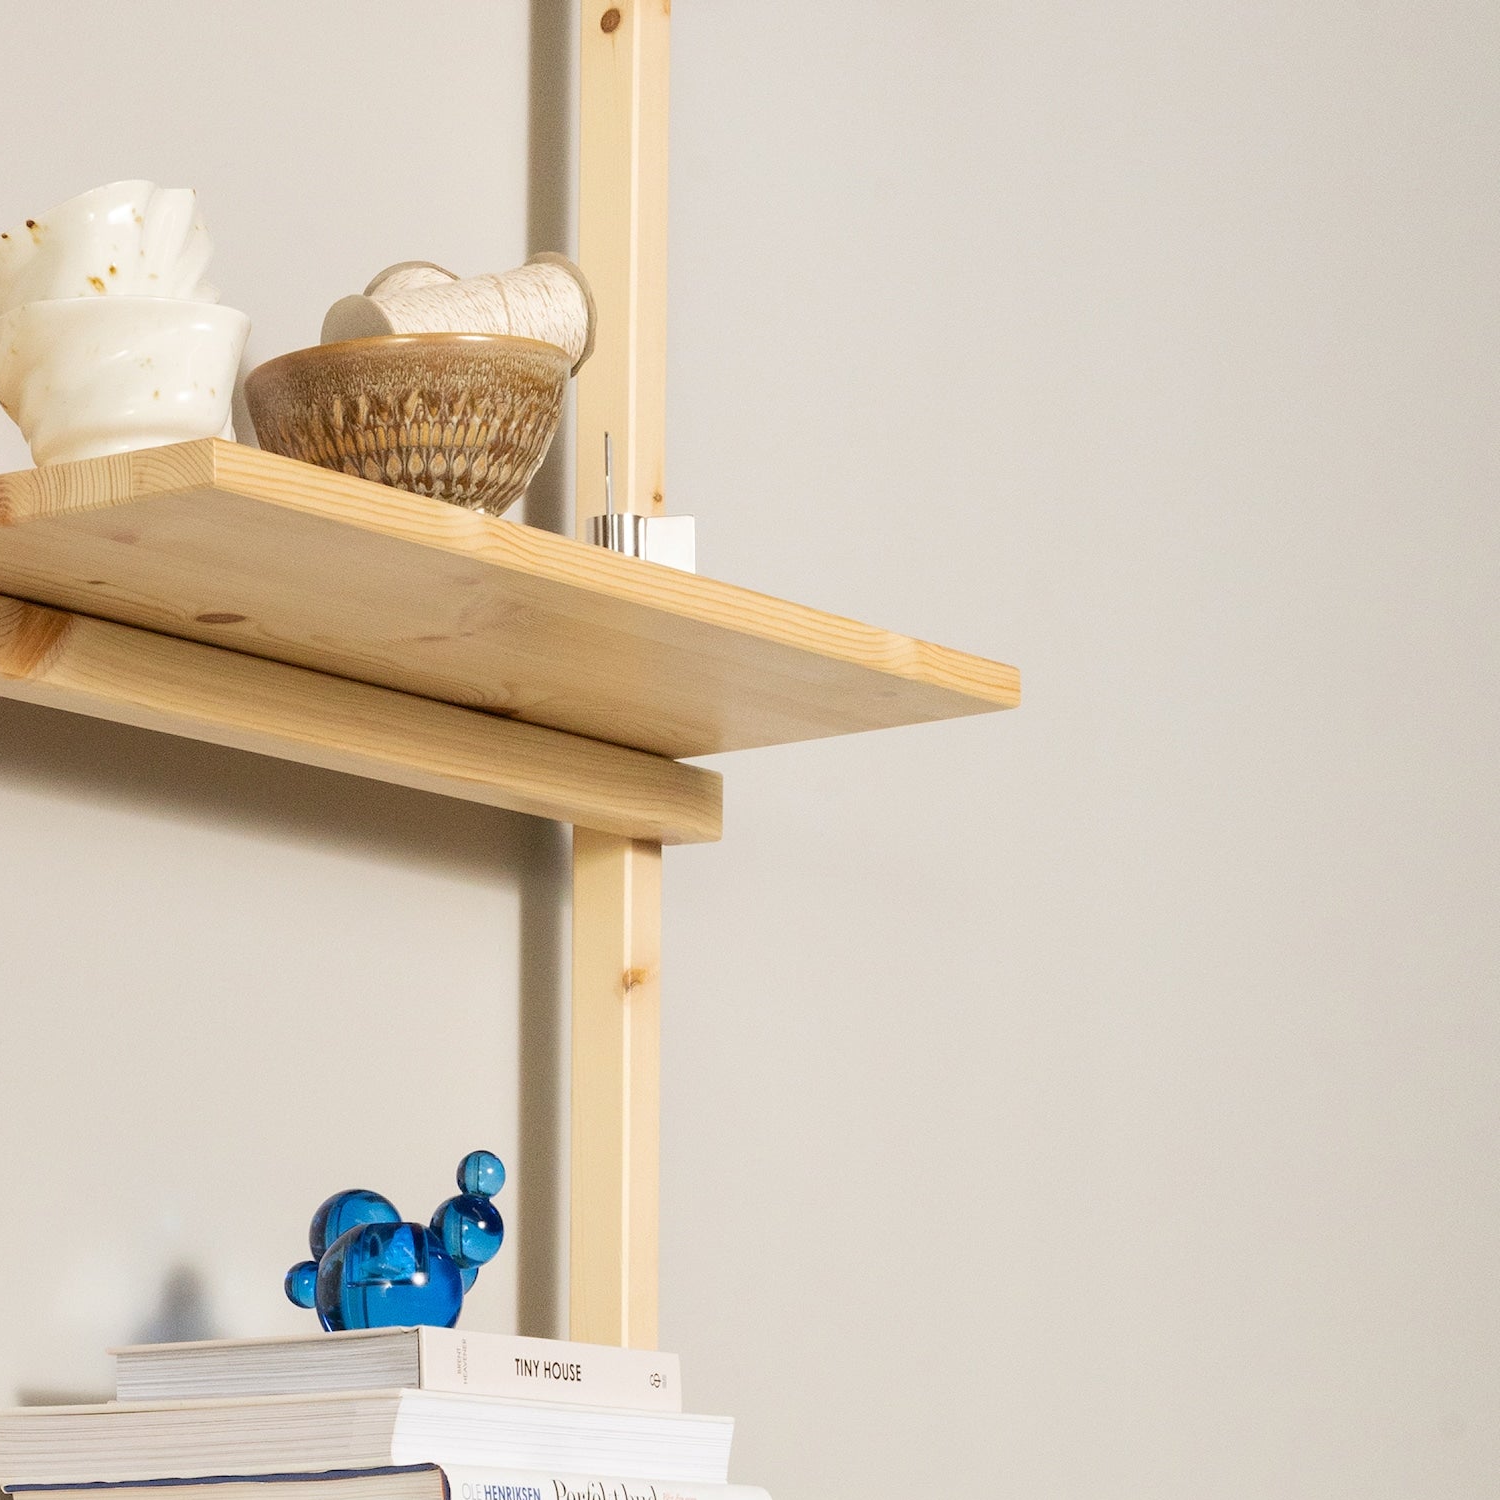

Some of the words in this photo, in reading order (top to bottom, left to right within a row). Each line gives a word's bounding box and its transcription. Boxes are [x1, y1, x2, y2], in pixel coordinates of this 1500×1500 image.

[514, 1358, 540, 1378] TINY
[544, 1361, 582, 1382] HOUSE
[461, 1482, 482, 1500] OLE
